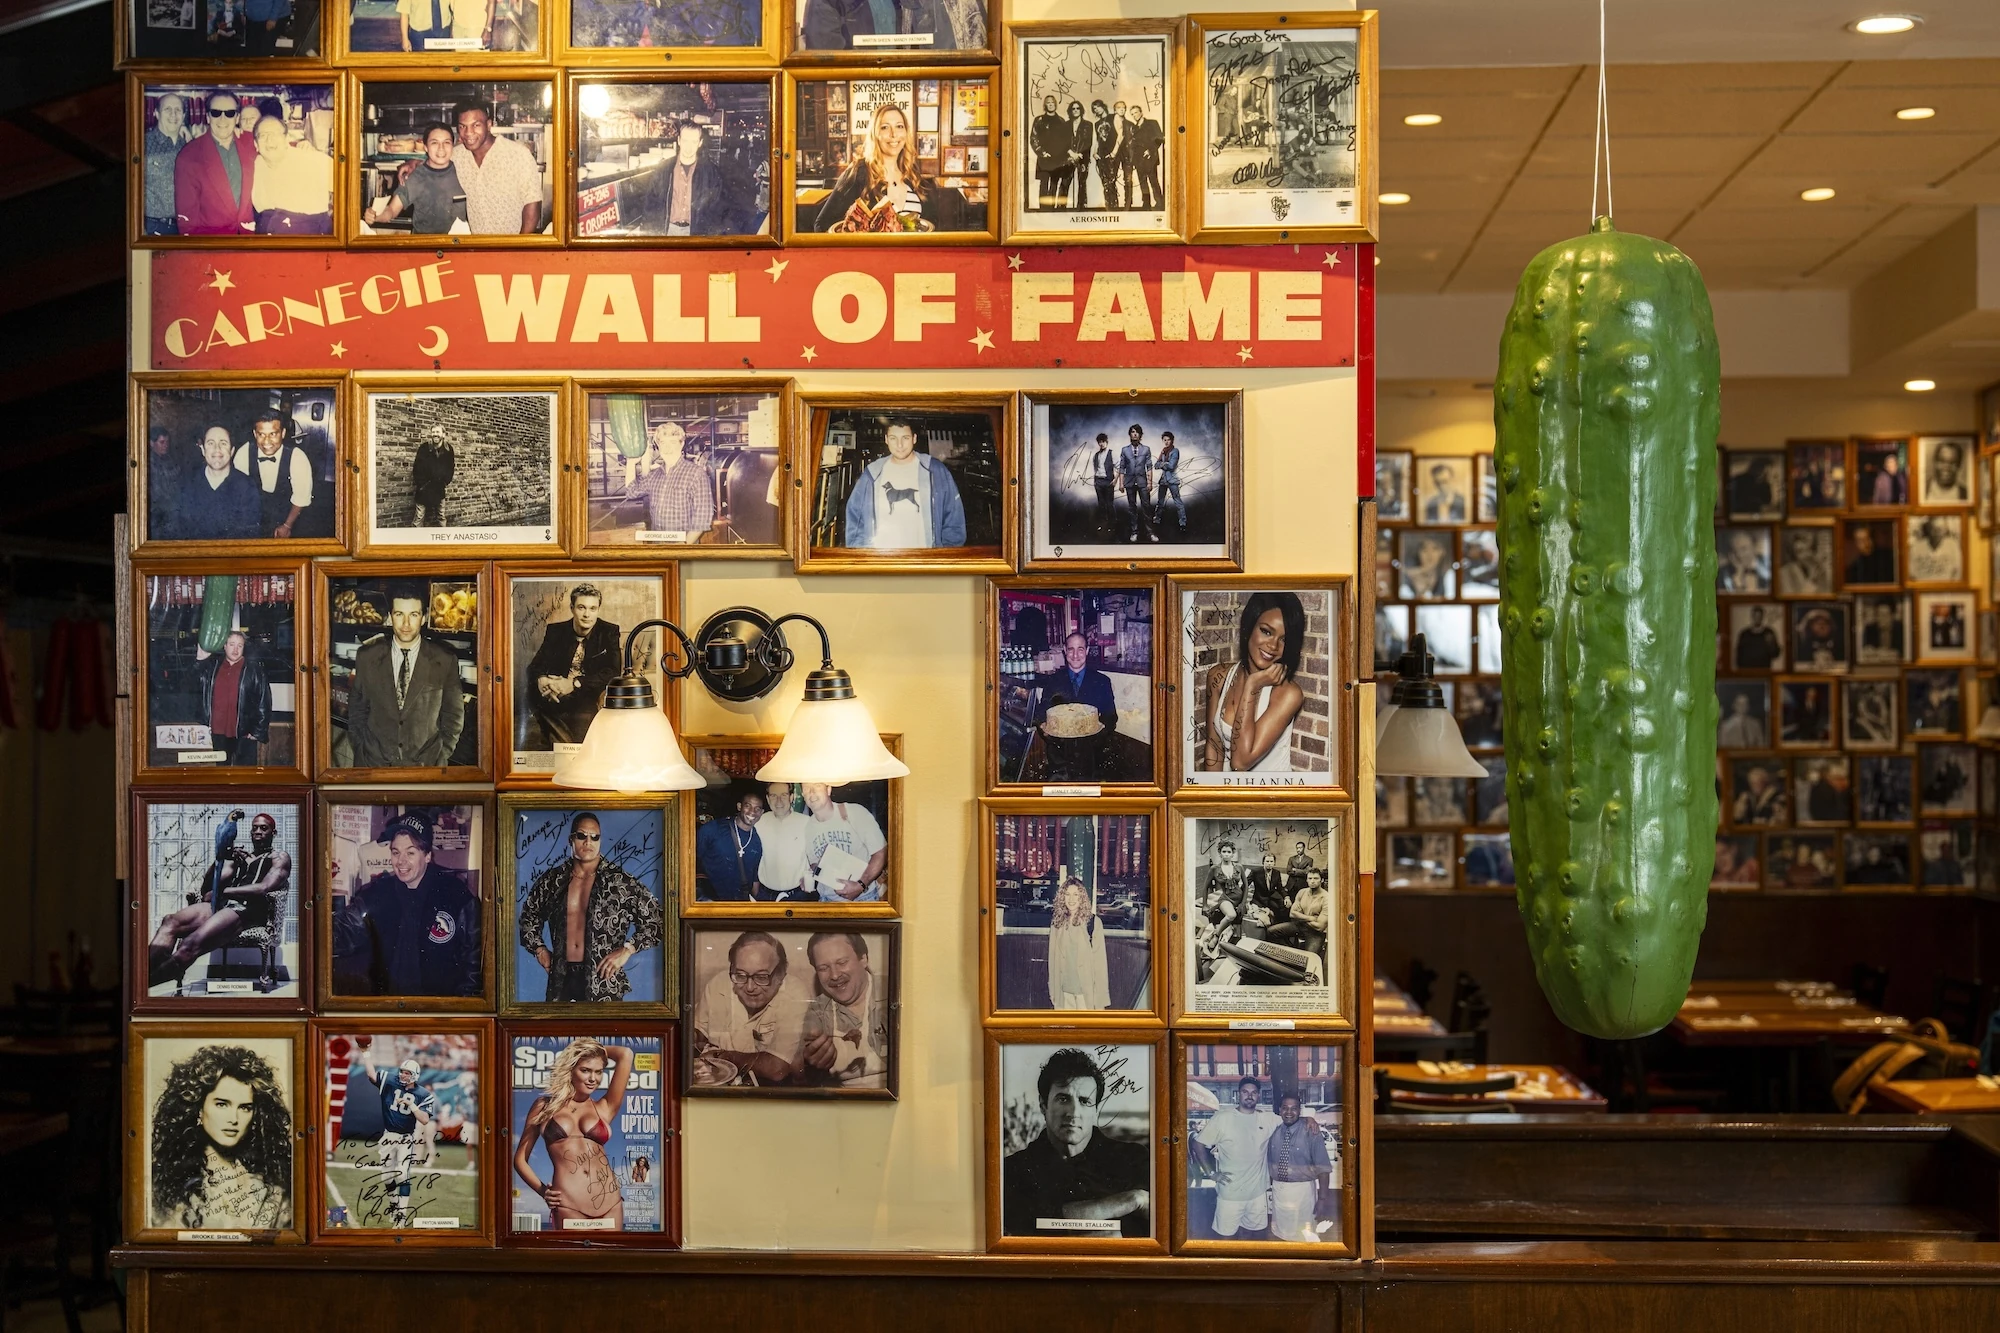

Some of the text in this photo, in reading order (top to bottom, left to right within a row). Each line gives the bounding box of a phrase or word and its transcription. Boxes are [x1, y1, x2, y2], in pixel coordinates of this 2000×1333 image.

[852, 82, 912, 93] SKYSCRAPERS
[869, 92, 895, 102] IN NYC
[856, 102, 872, 111] ARE
[899, 101, 909, 111] OF
[164, 259, 460, 358] CARNEGIE
[473, 270, 1323, 344] WALL OF FAME
[828, 831, 852, 844] SALLE
[627, 1096, 654, 1114] KATE
[621, 1115, 659, 1133] UPTON
